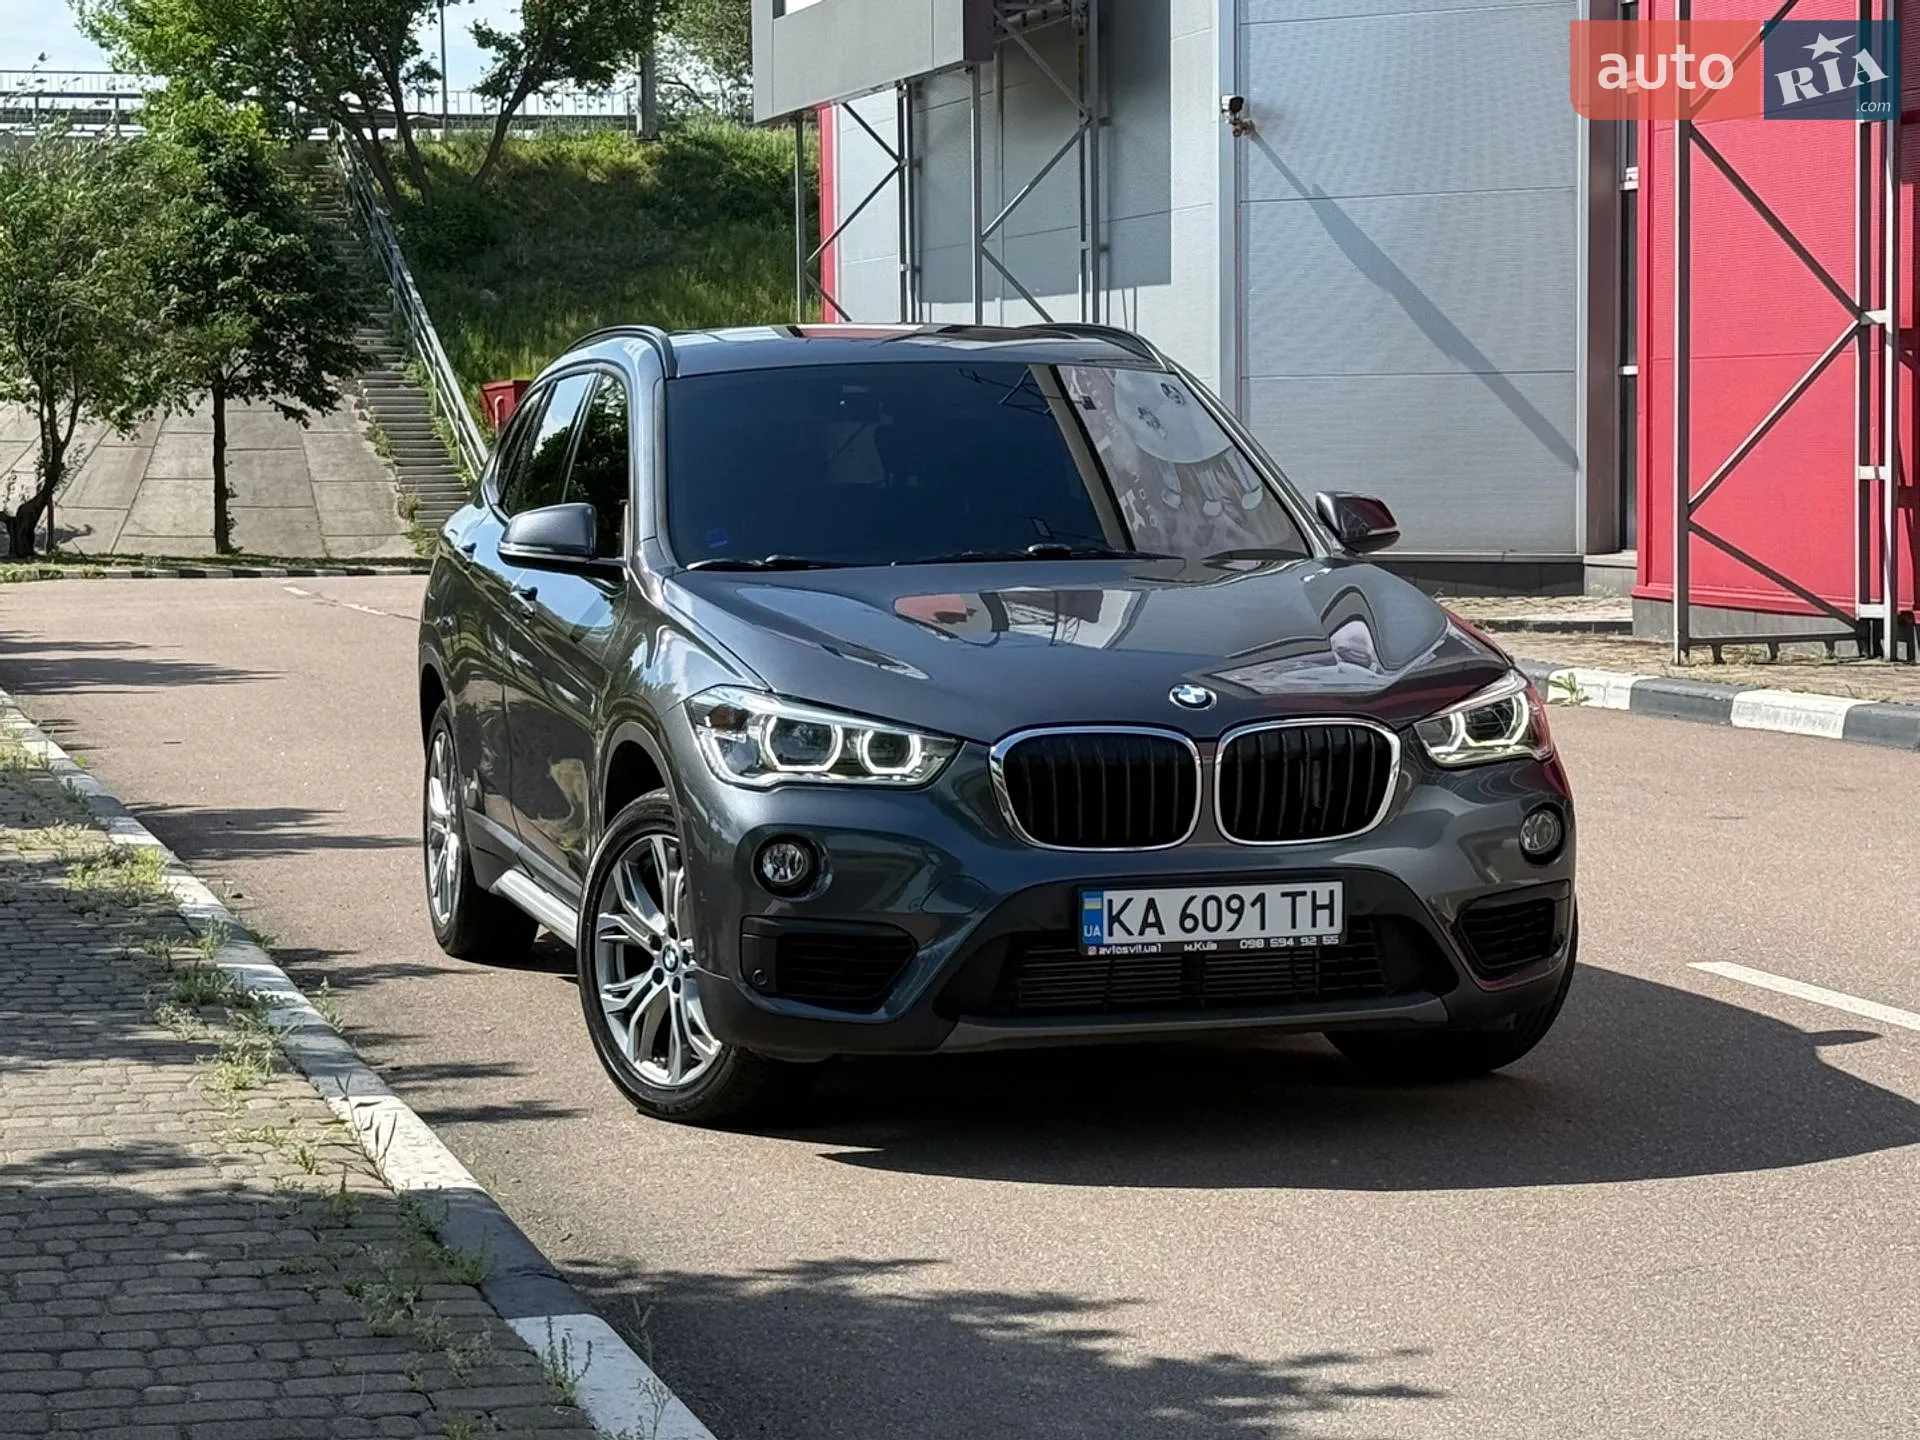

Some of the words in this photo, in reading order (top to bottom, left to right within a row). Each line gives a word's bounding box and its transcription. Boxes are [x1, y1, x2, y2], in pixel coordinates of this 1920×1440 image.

[1106, 897, 1166, 937] KA
[1179, 893, 1266, 933] 6091
[1280, 889, 1335, 930] TH
[1084, 925, 1101, 937] UA
